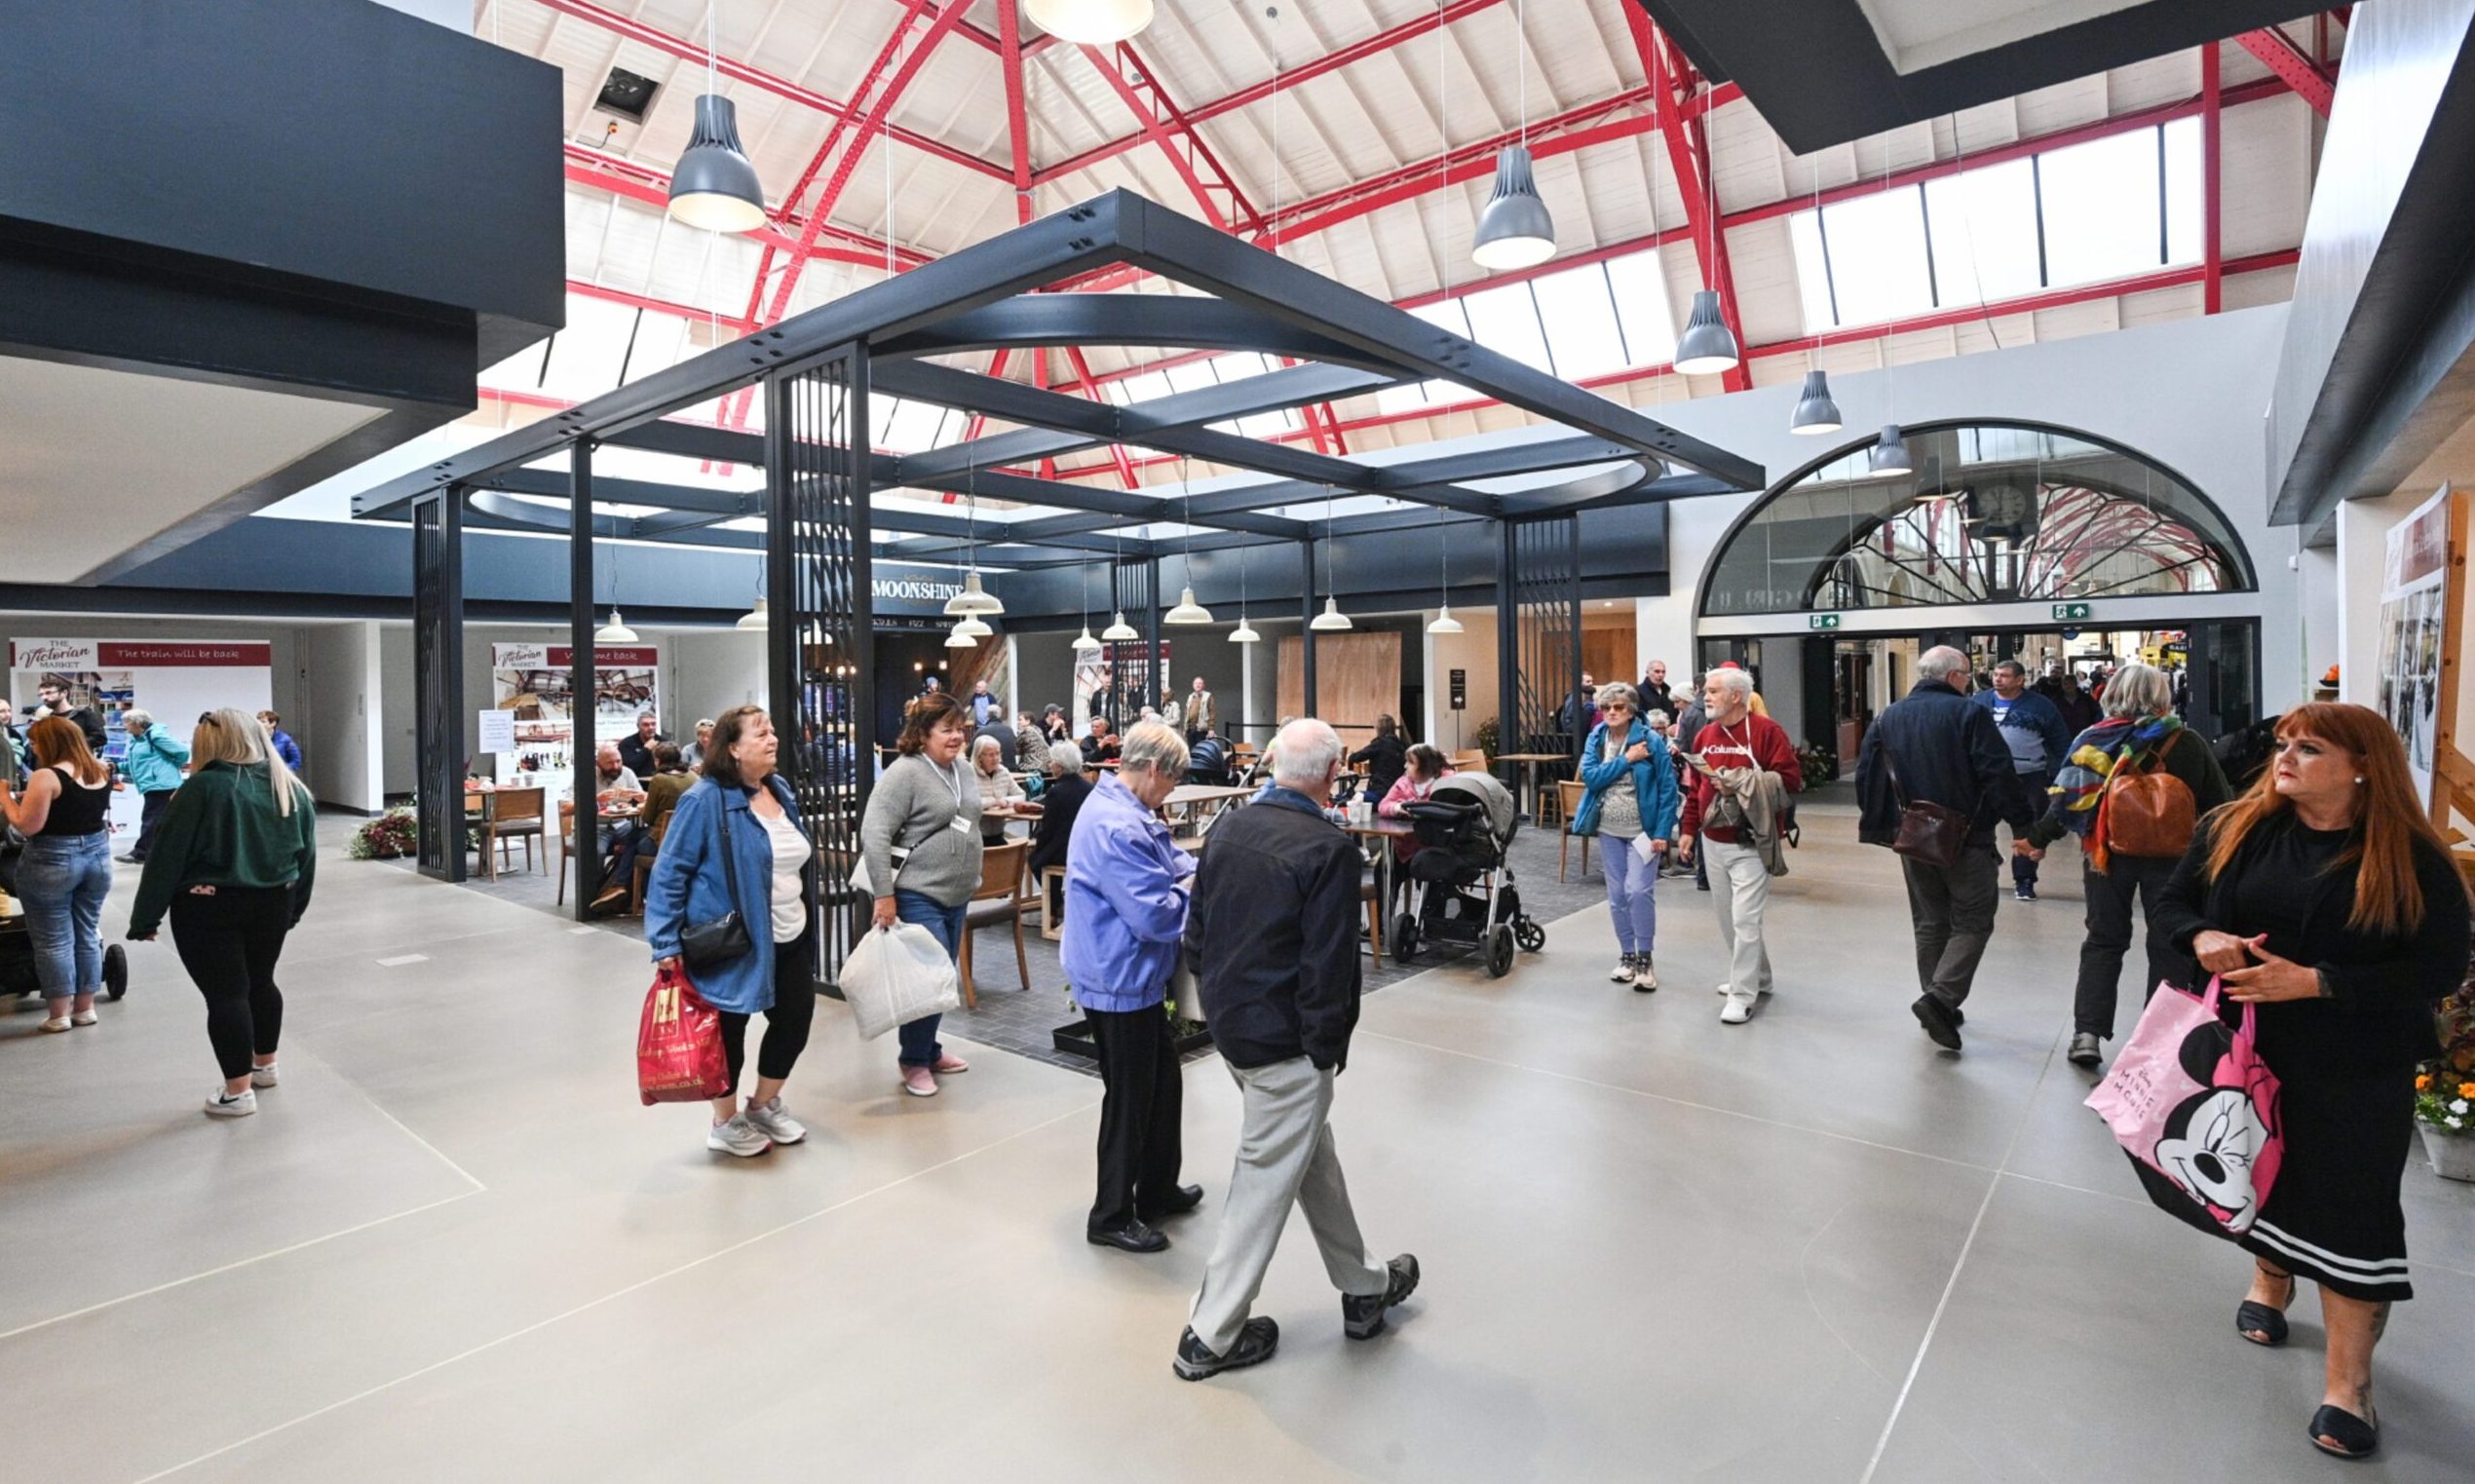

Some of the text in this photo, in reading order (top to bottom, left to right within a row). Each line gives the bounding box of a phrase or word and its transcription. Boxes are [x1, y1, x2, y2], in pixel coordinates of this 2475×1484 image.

[871, 580, 964, 599] MOONSHINE
[19, 647, 91, 668] Victorian
[117, 649, 240, 660] The train will be back
[613, 651, 638, 661] back
